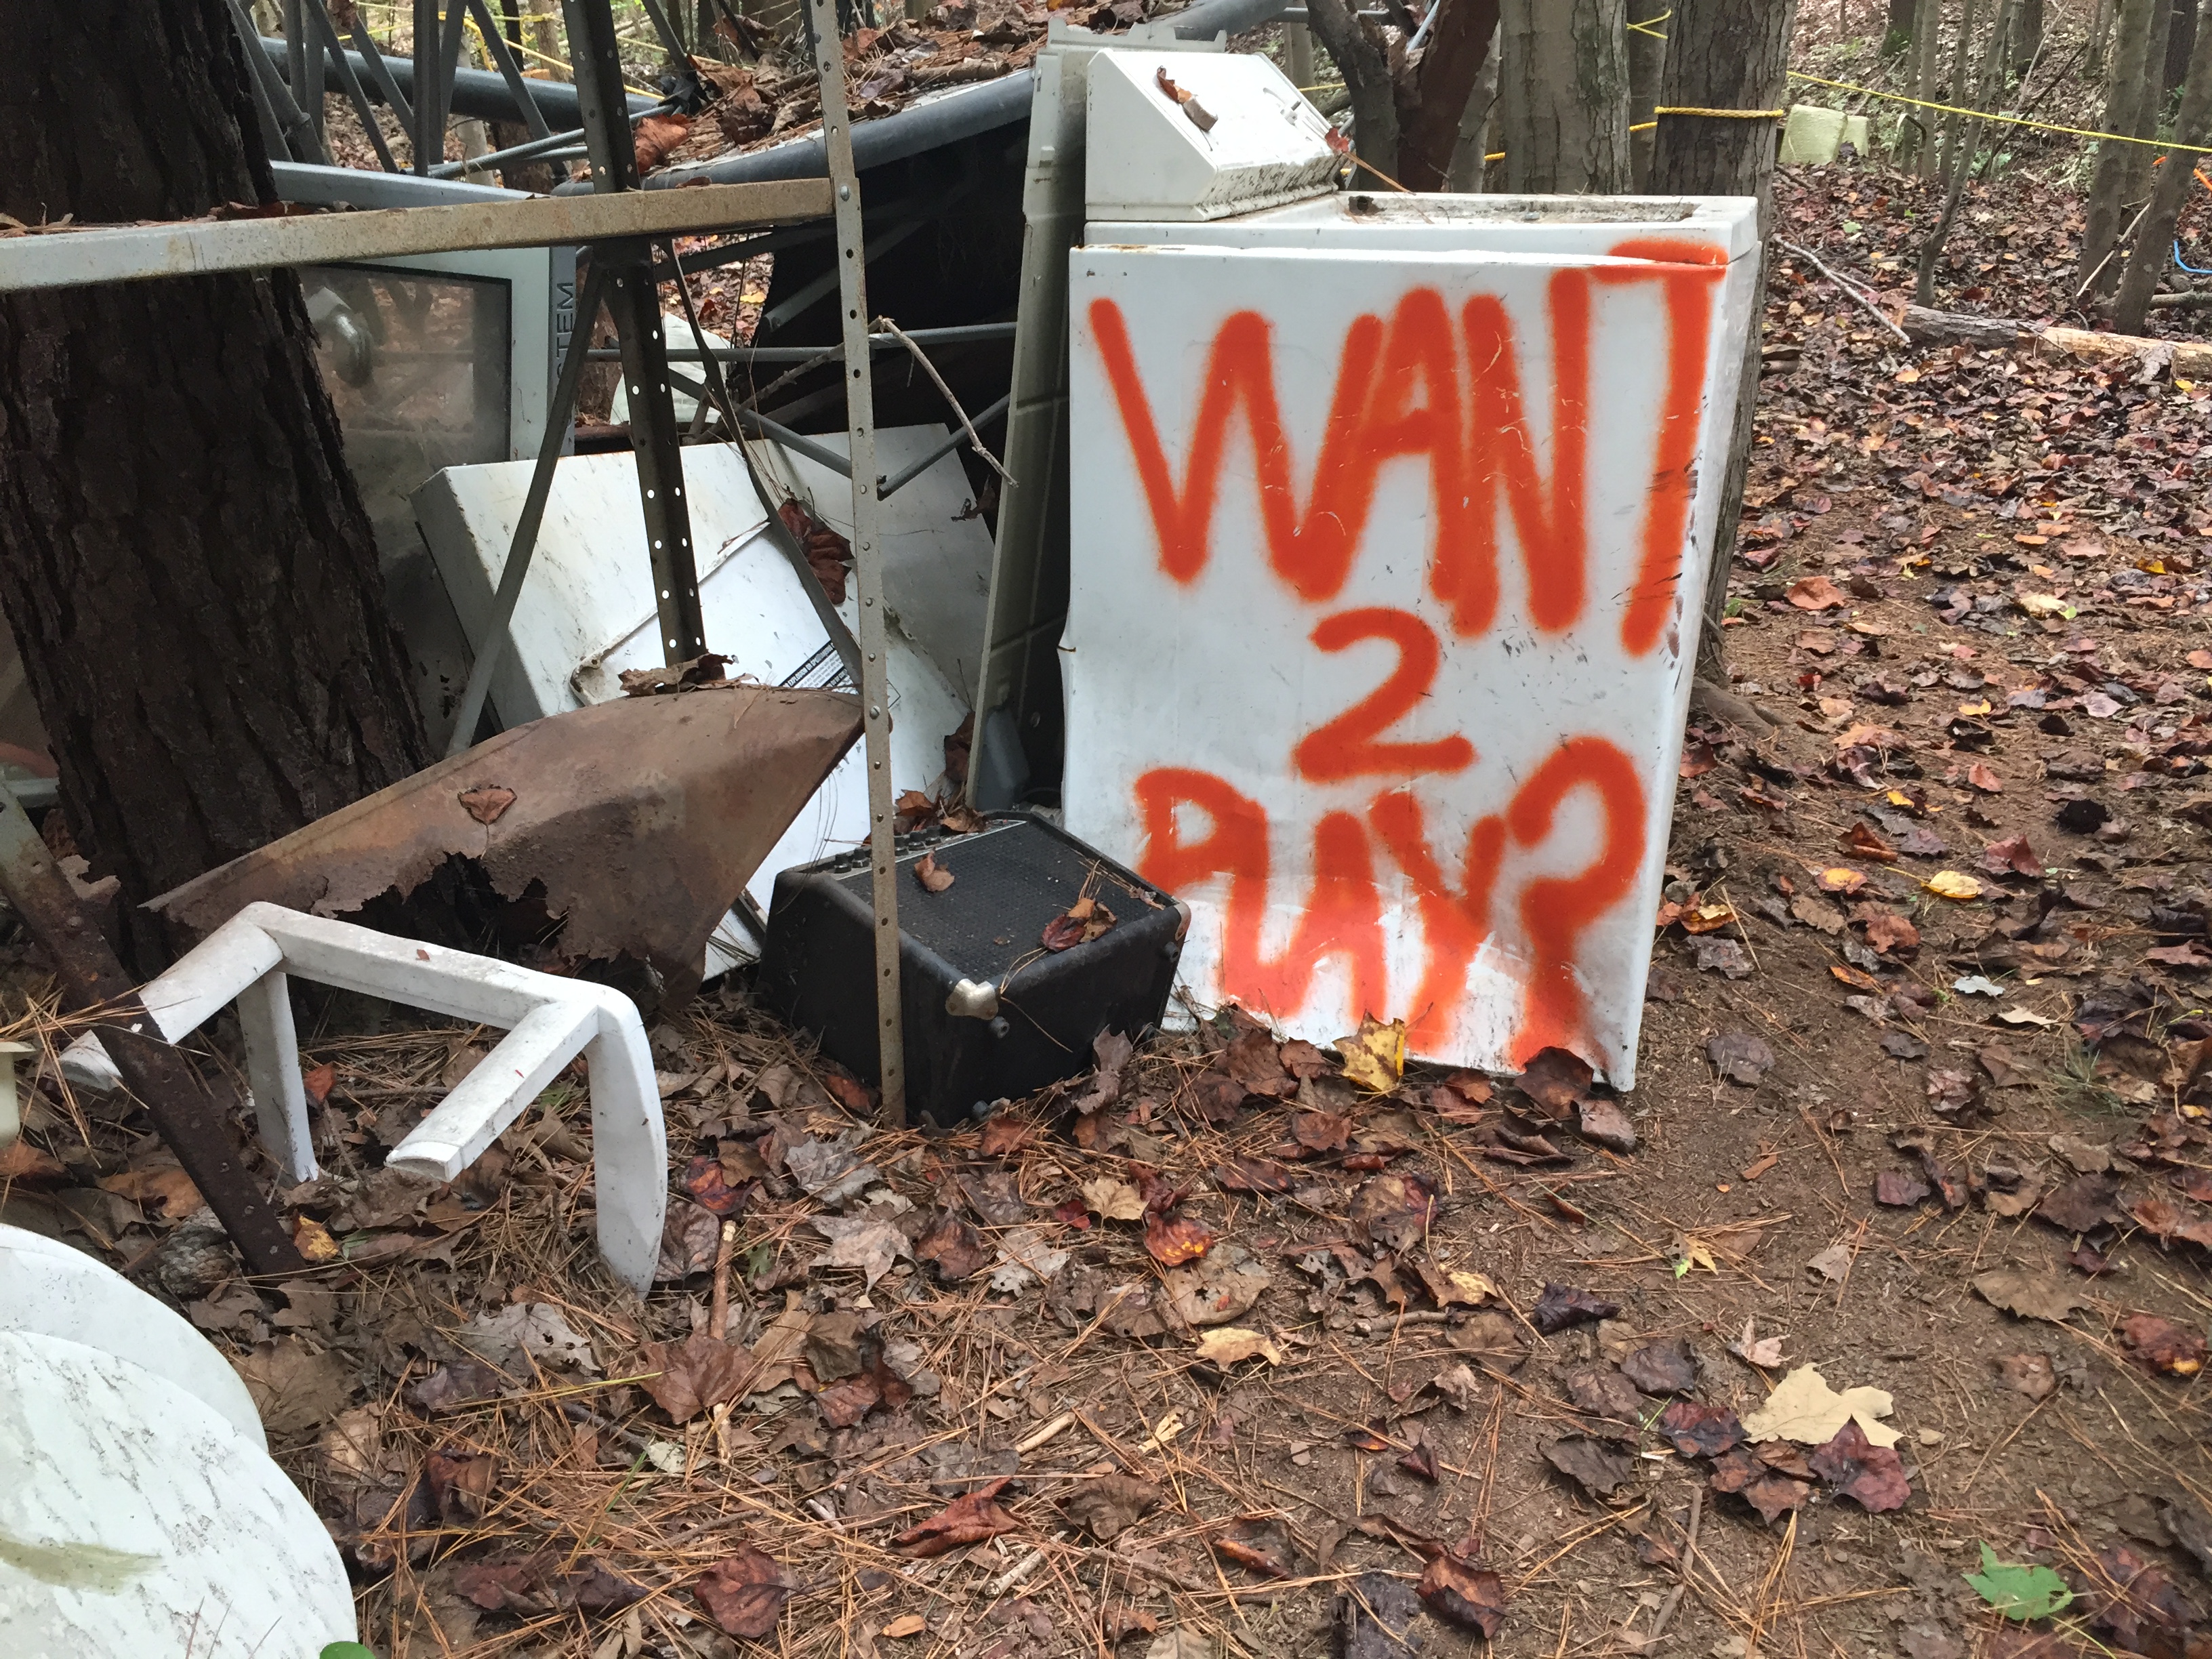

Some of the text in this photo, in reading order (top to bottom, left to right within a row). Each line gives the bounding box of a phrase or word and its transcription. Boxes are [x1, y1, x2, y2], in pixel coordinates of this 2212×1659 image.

[1089, 239, 1726, 654] WANT
[1296, 607, 1476, 783] 2
[1135, 735, 1647, 1072] PLAY?
